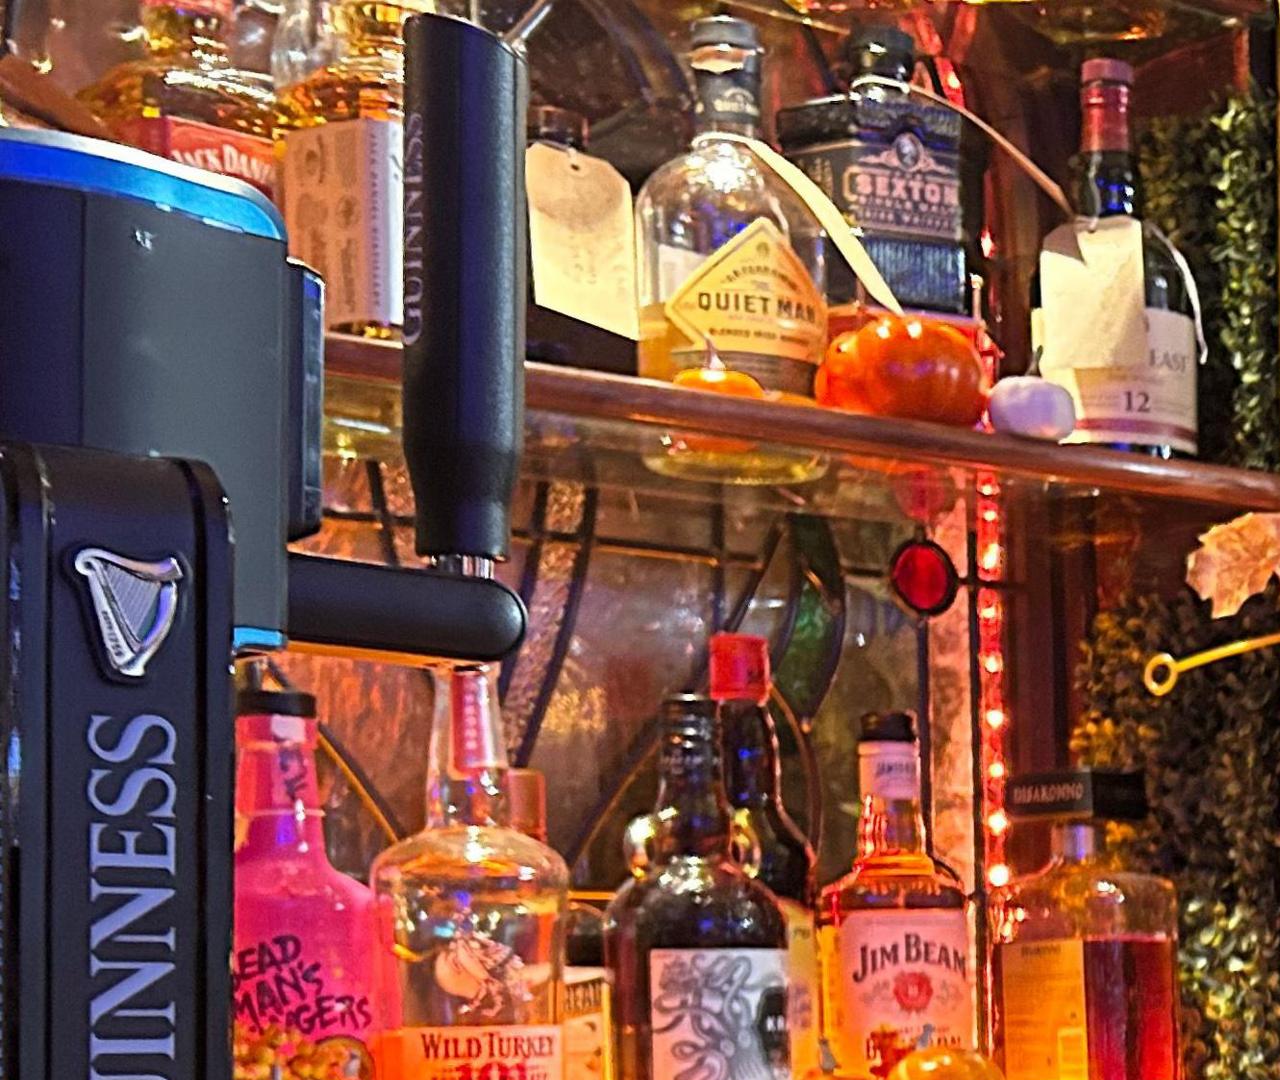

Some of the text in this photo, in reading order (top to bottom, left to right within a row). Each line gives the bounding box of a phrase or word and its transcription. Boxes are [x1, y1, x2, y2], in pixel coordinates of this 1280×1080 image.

[403, 113, 424, 346] GUINNESS
[698, 292, 817, 325] QUIET MAN
[1124, 390, 1151, 413] 12
[234, 935, 302, 981] EAD
[853, 933, 967, 982] JIM BEAM
[421, 1031, 555, 1060] WILD TURKEY
